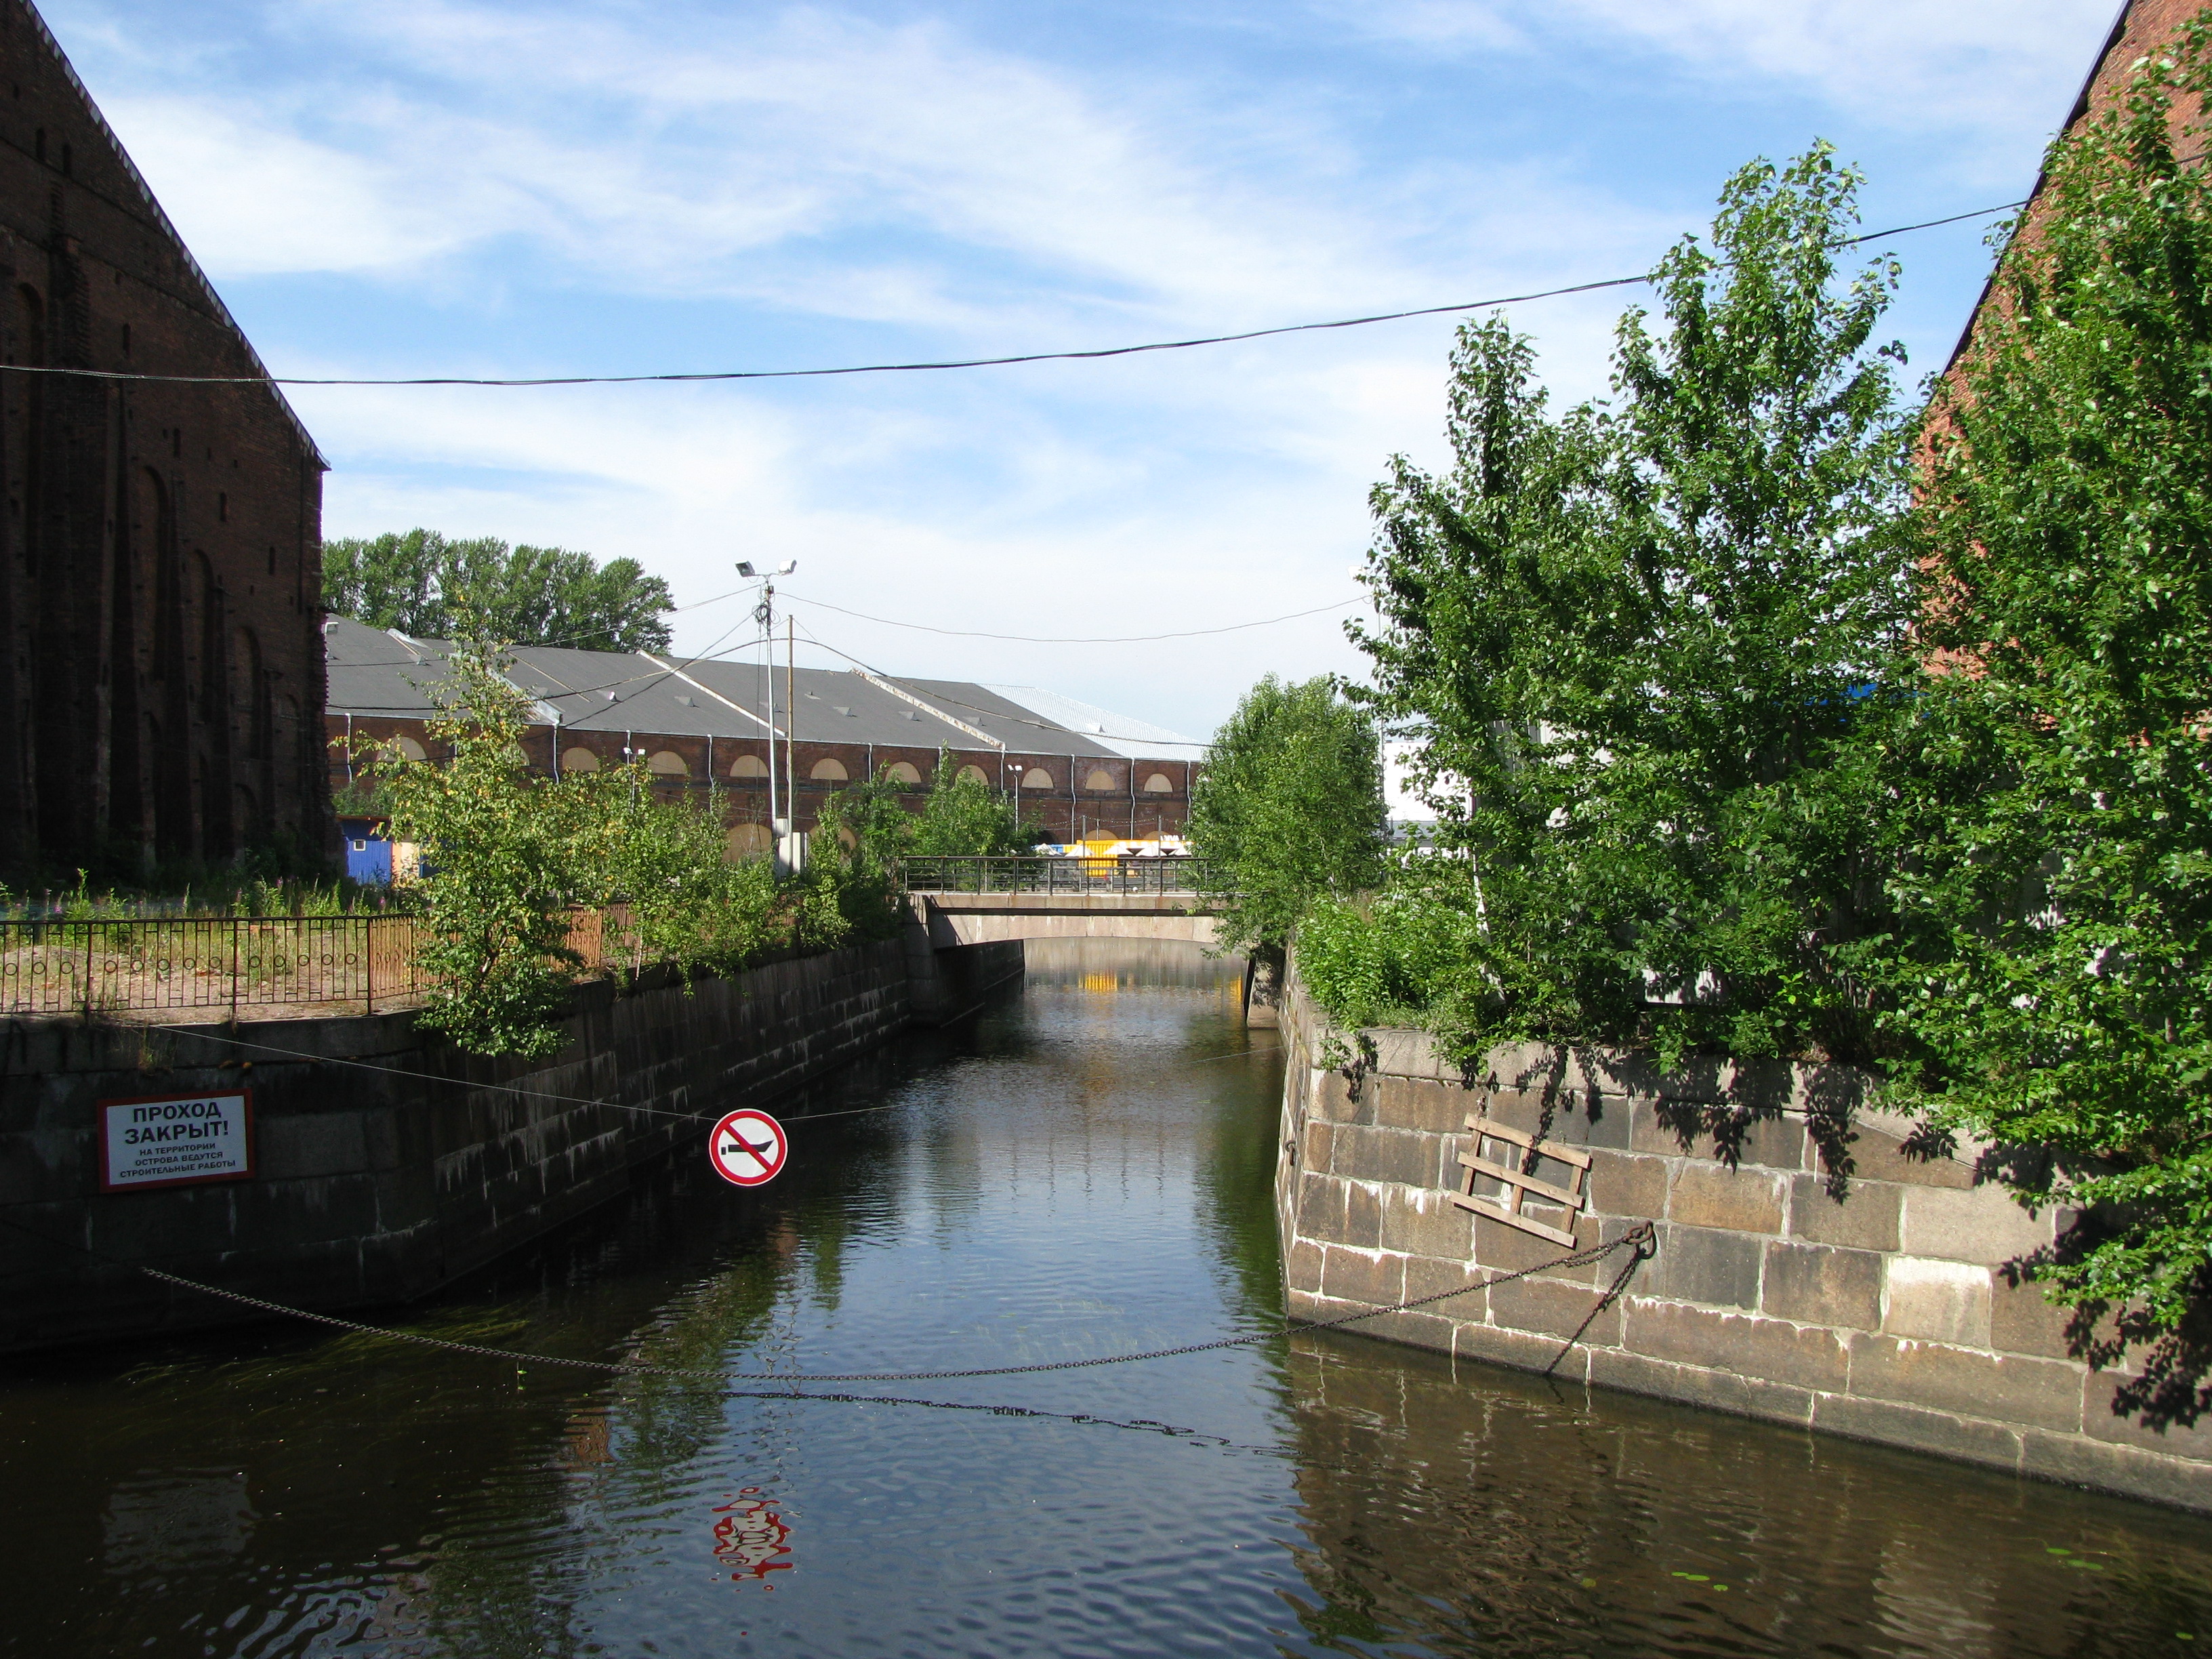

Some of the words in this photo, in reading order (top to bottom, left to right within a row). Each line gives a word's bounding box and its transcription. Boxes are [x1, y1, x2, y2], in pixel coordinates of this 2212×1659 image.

[134, 1102, 222, 1122] ПРОХОД
[125, 1120, 229, 1145] ЗАКРЫТ!
[155, 1143, 216, 1154] ТЕРРИТОРИИ
[136, 1155, 179, 1166] ОСТРОВА
[182, 1151, 223, 1162] ВЕДУТСЯ
[120, 1164, 195, 1178] СТРОИТЕЛЬНЫЕ
[198, 1160, 236, 1170] РАБОТЫ
